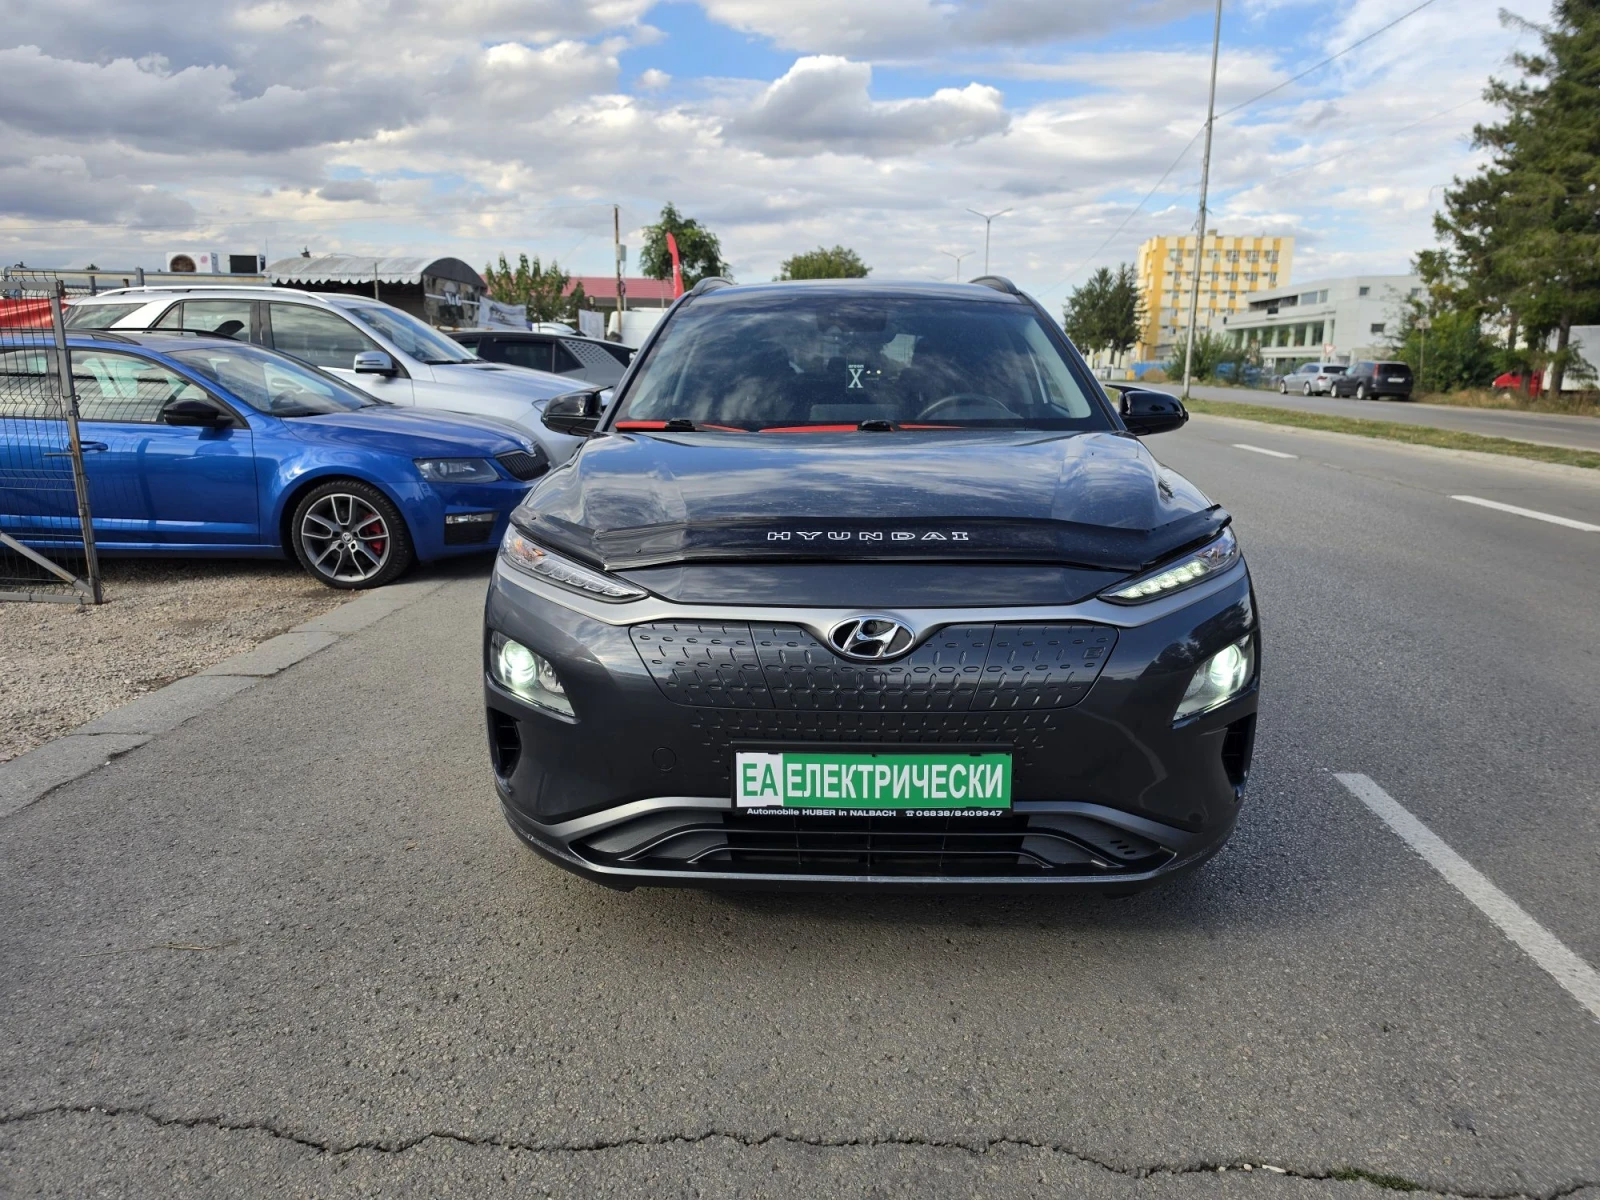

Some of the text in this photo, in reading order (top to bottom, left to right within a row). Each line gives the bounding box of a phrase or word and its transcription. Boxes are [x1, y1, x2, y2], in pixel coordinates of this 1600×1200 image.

[848, 369, 864, 388] X
[767, 531, 970, 541] HYUNDAI
[786, 763, 1004, 799] ЕЛЕКТРИЧЕСКИ
[746, 808, 800, 816] Automobile
[838, 809, 847, 817] in
[850, 809, 897, 817] NALBACH
